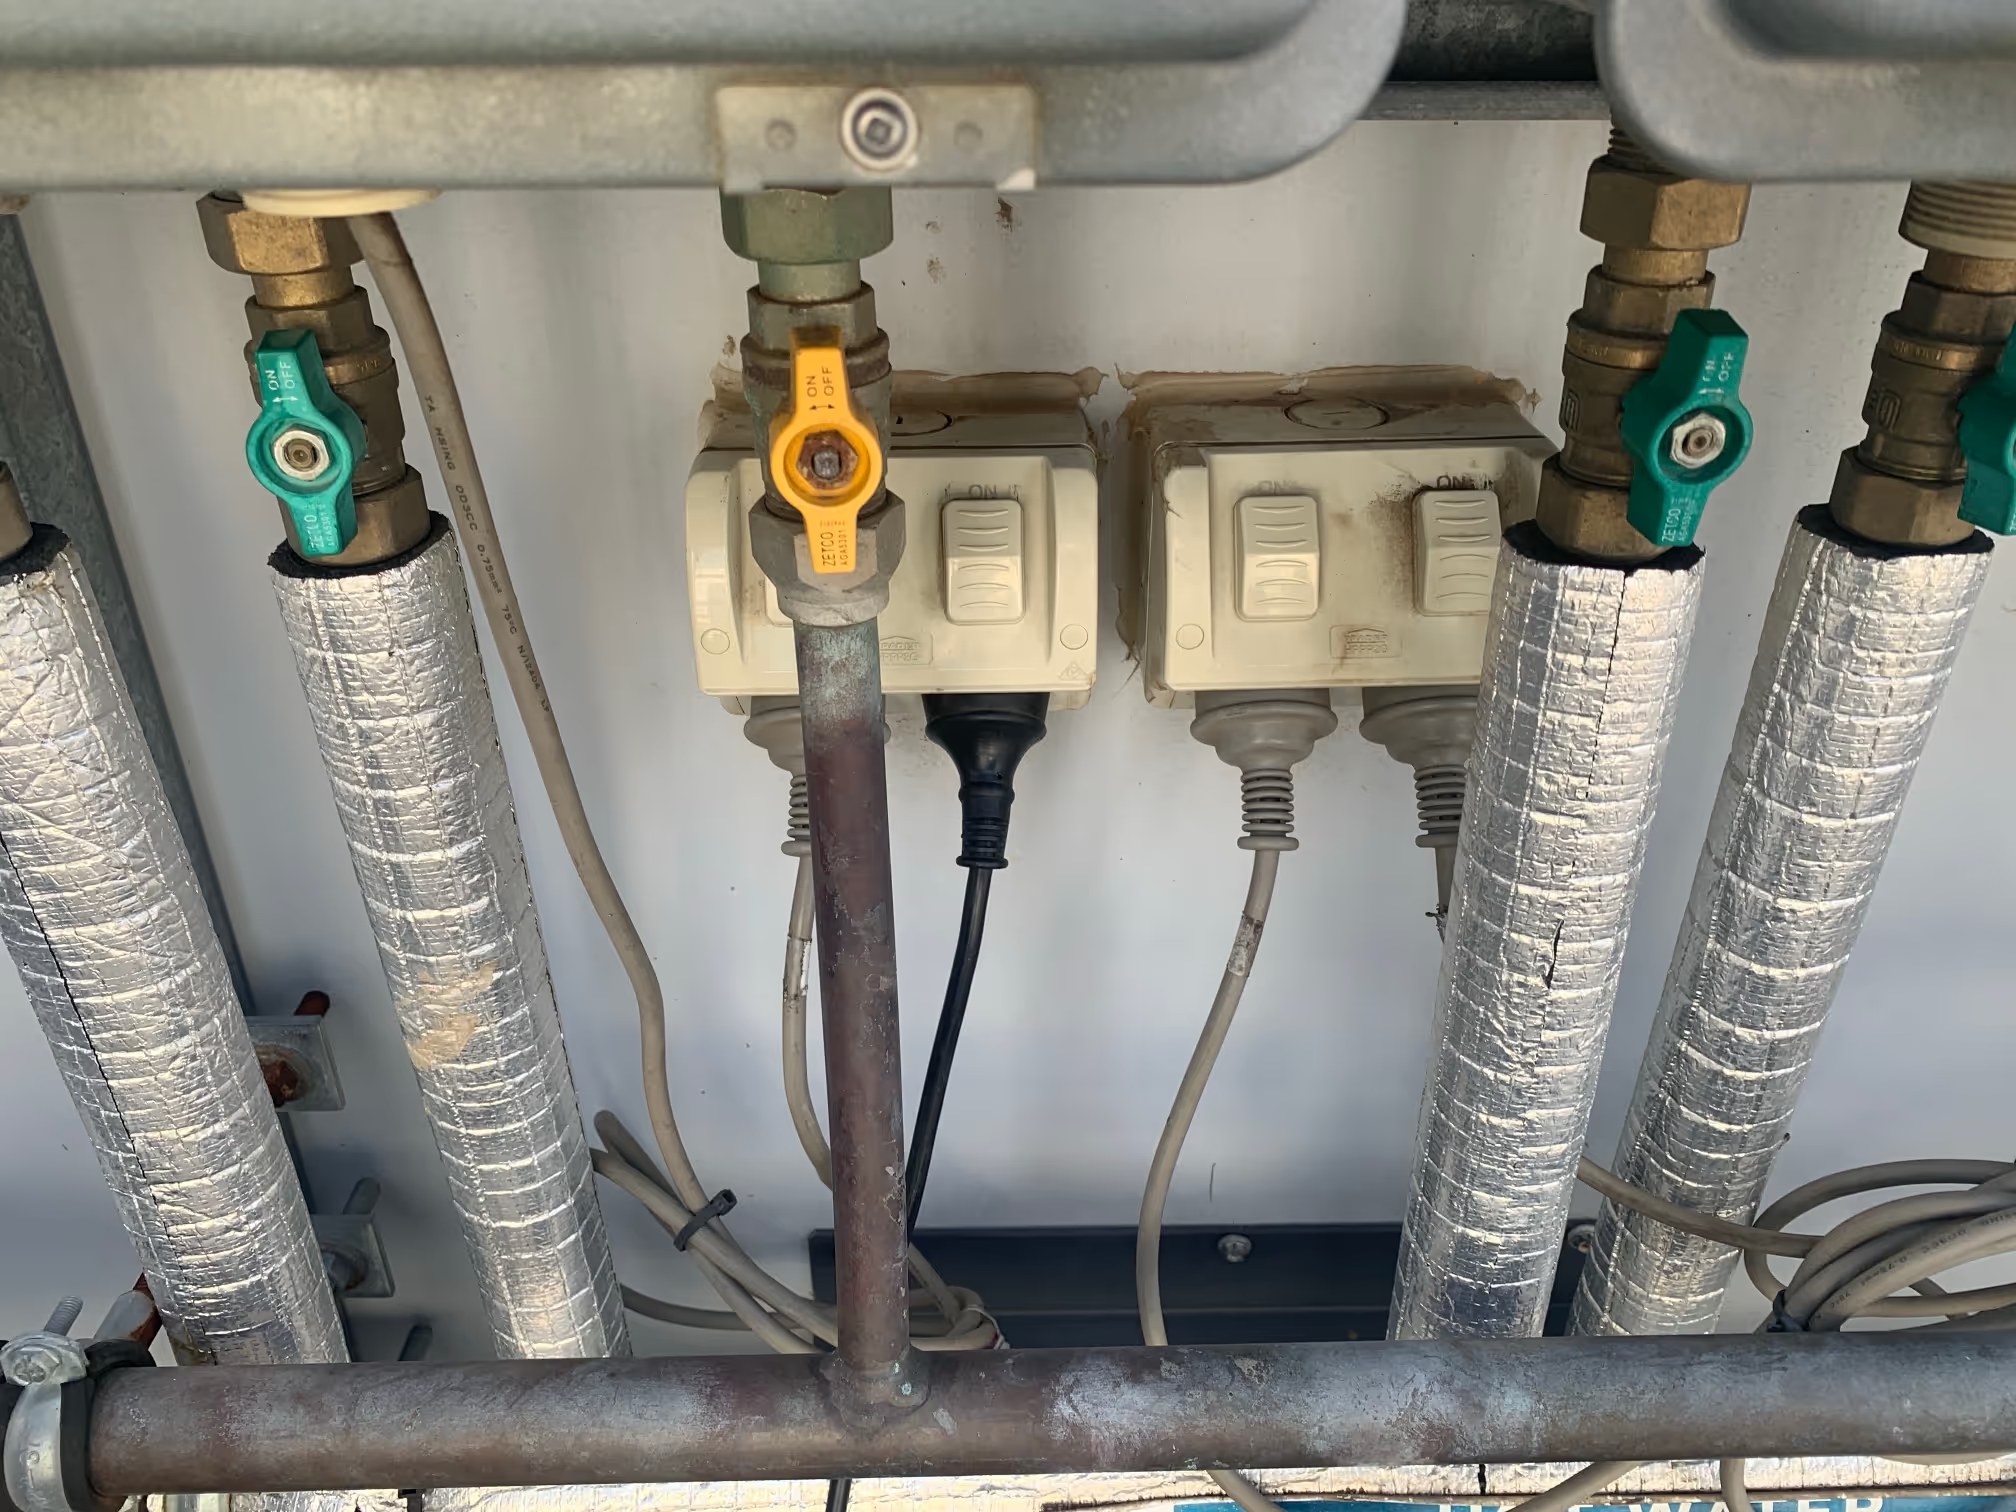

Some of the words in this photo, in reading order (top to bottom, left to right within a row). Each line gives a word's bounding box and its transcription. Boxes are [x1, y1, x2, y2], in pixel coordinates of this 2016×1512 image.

[265, 370, 280, 391] ON
[279, 361, 296, 389] OFF
[806, 375, 817, 397] ON
[821, 366, 835, 397] OFF
[967, 483, 998, 499] ON
[820, 532, 836, 567] ZETCO
